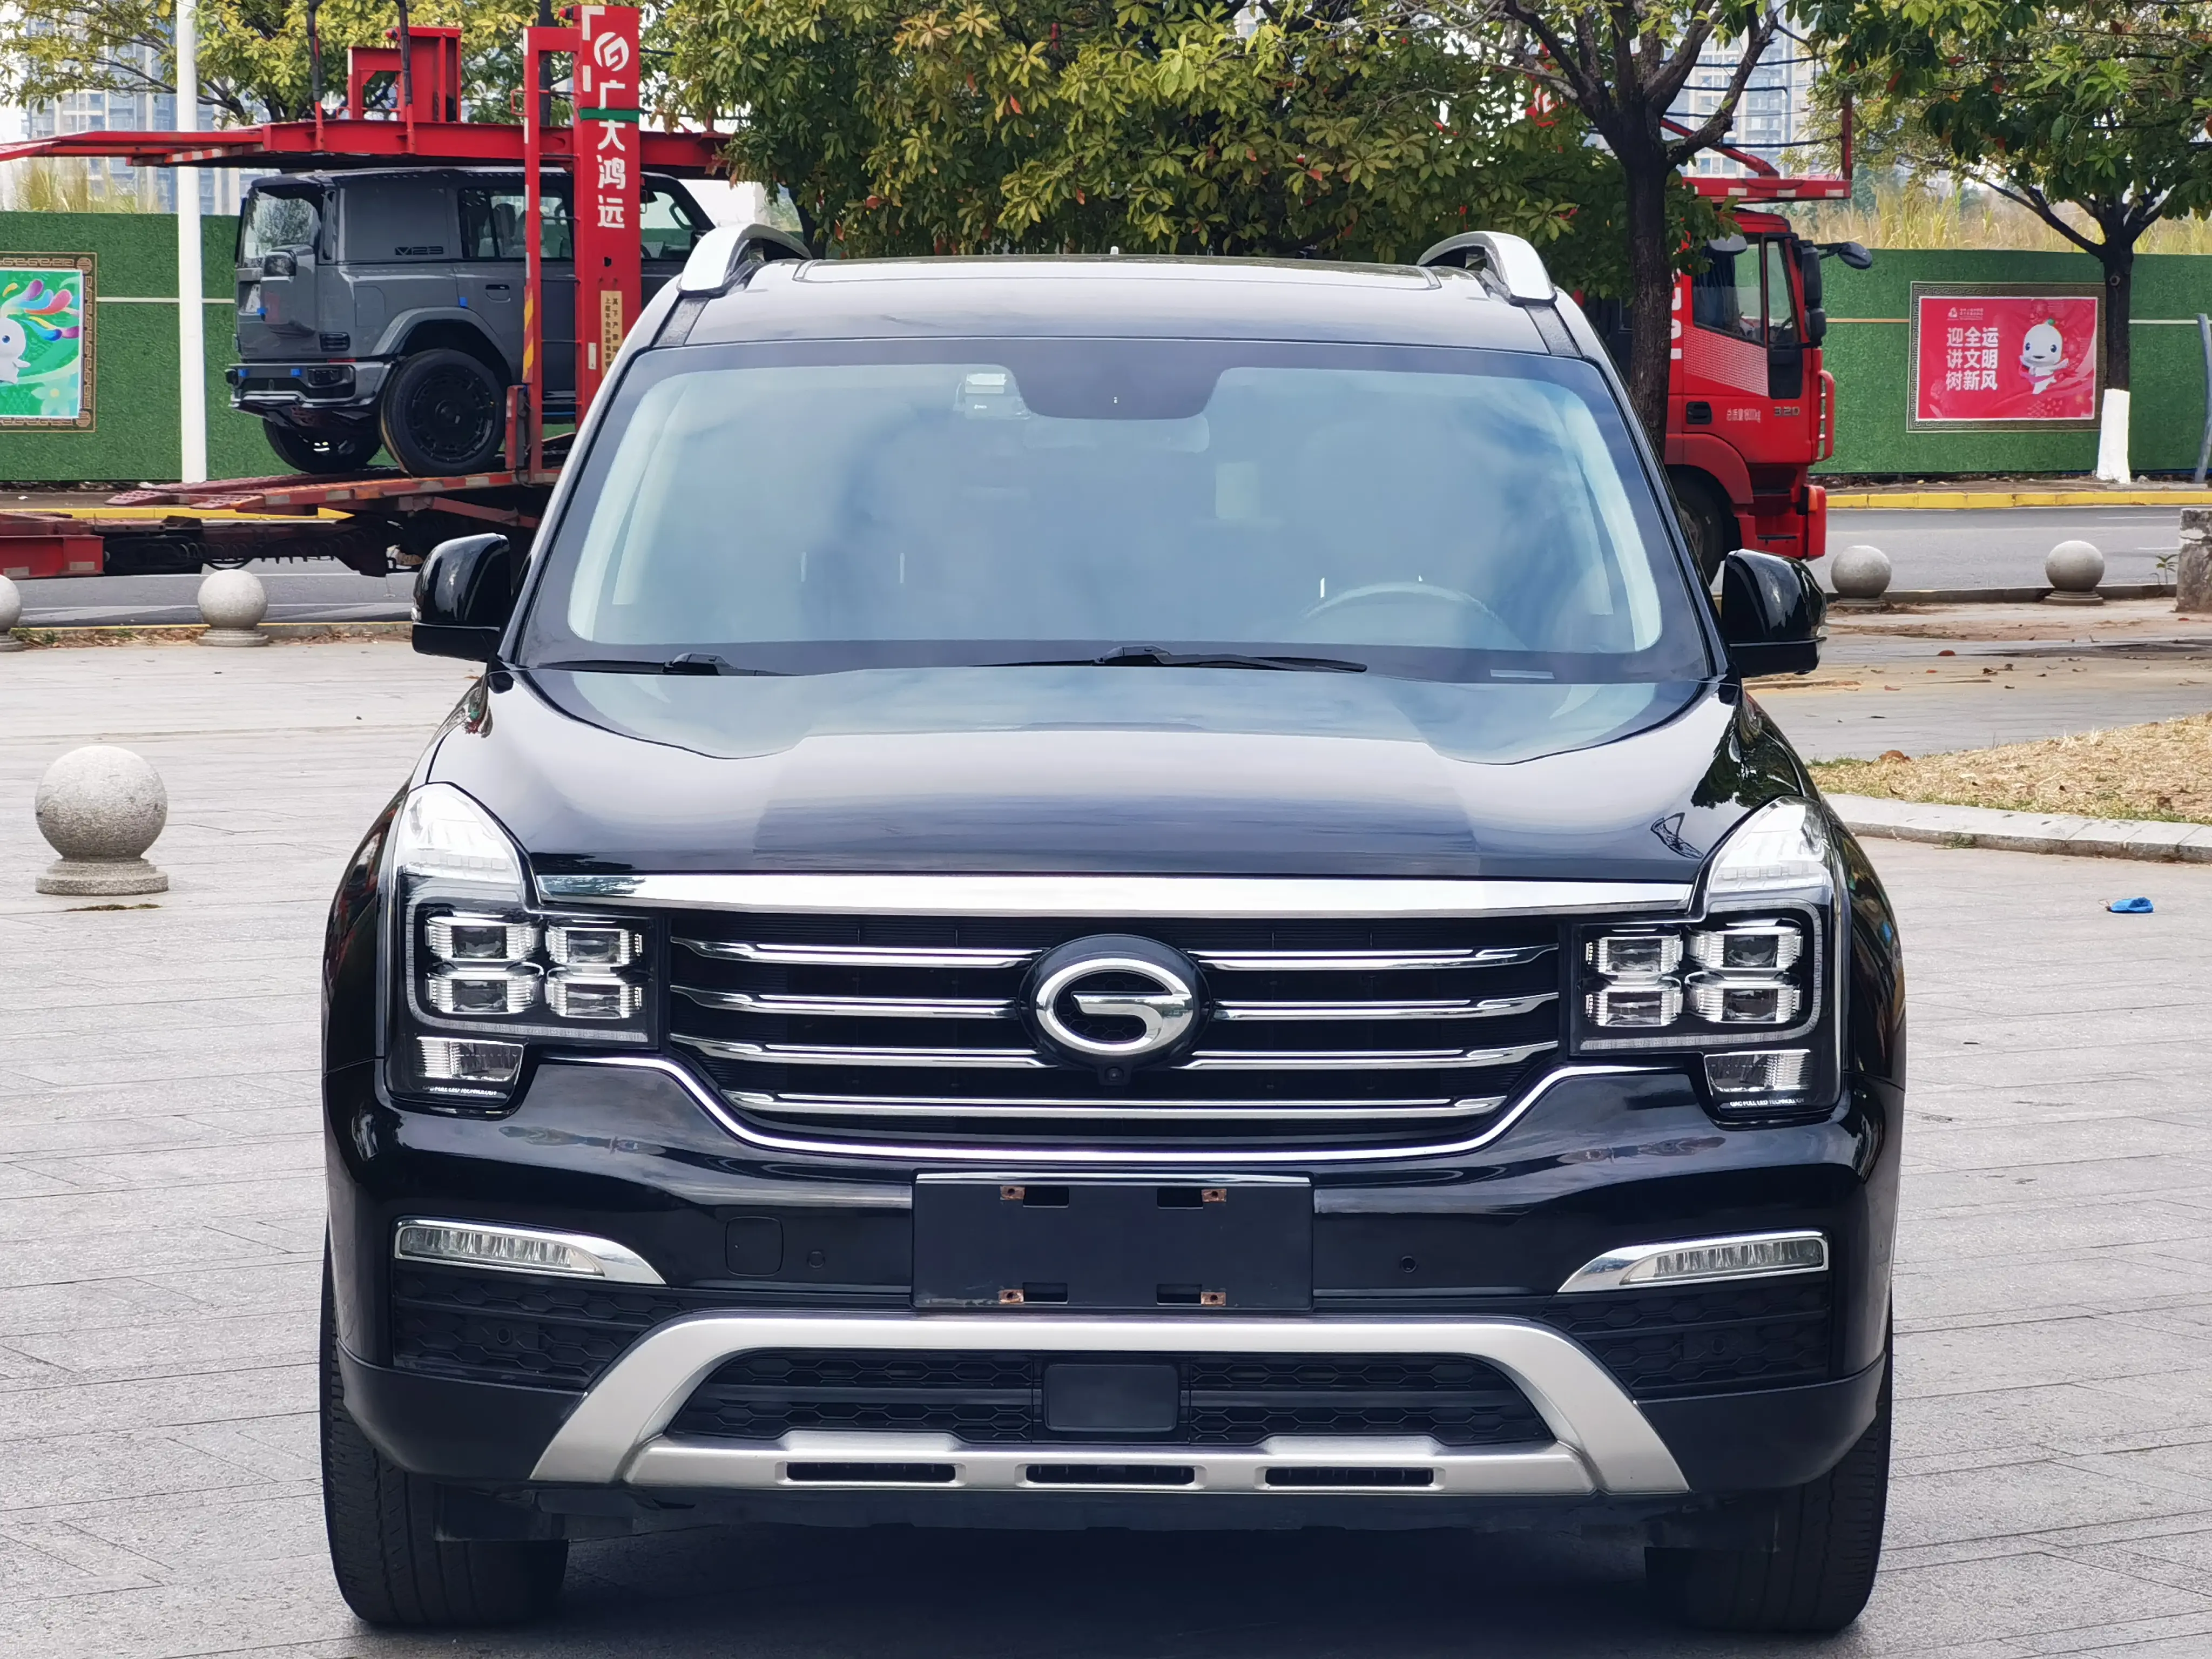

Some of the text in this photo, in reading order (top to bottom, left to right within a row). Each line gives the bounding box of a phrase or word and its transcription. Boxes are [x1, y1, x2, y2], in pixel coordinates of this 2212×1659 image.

[1946, 326, 1999, 347] 迎全运
[1946, 348, 1998, 369] 讲文明
[1946, 369, 1998, 391] 树新风
